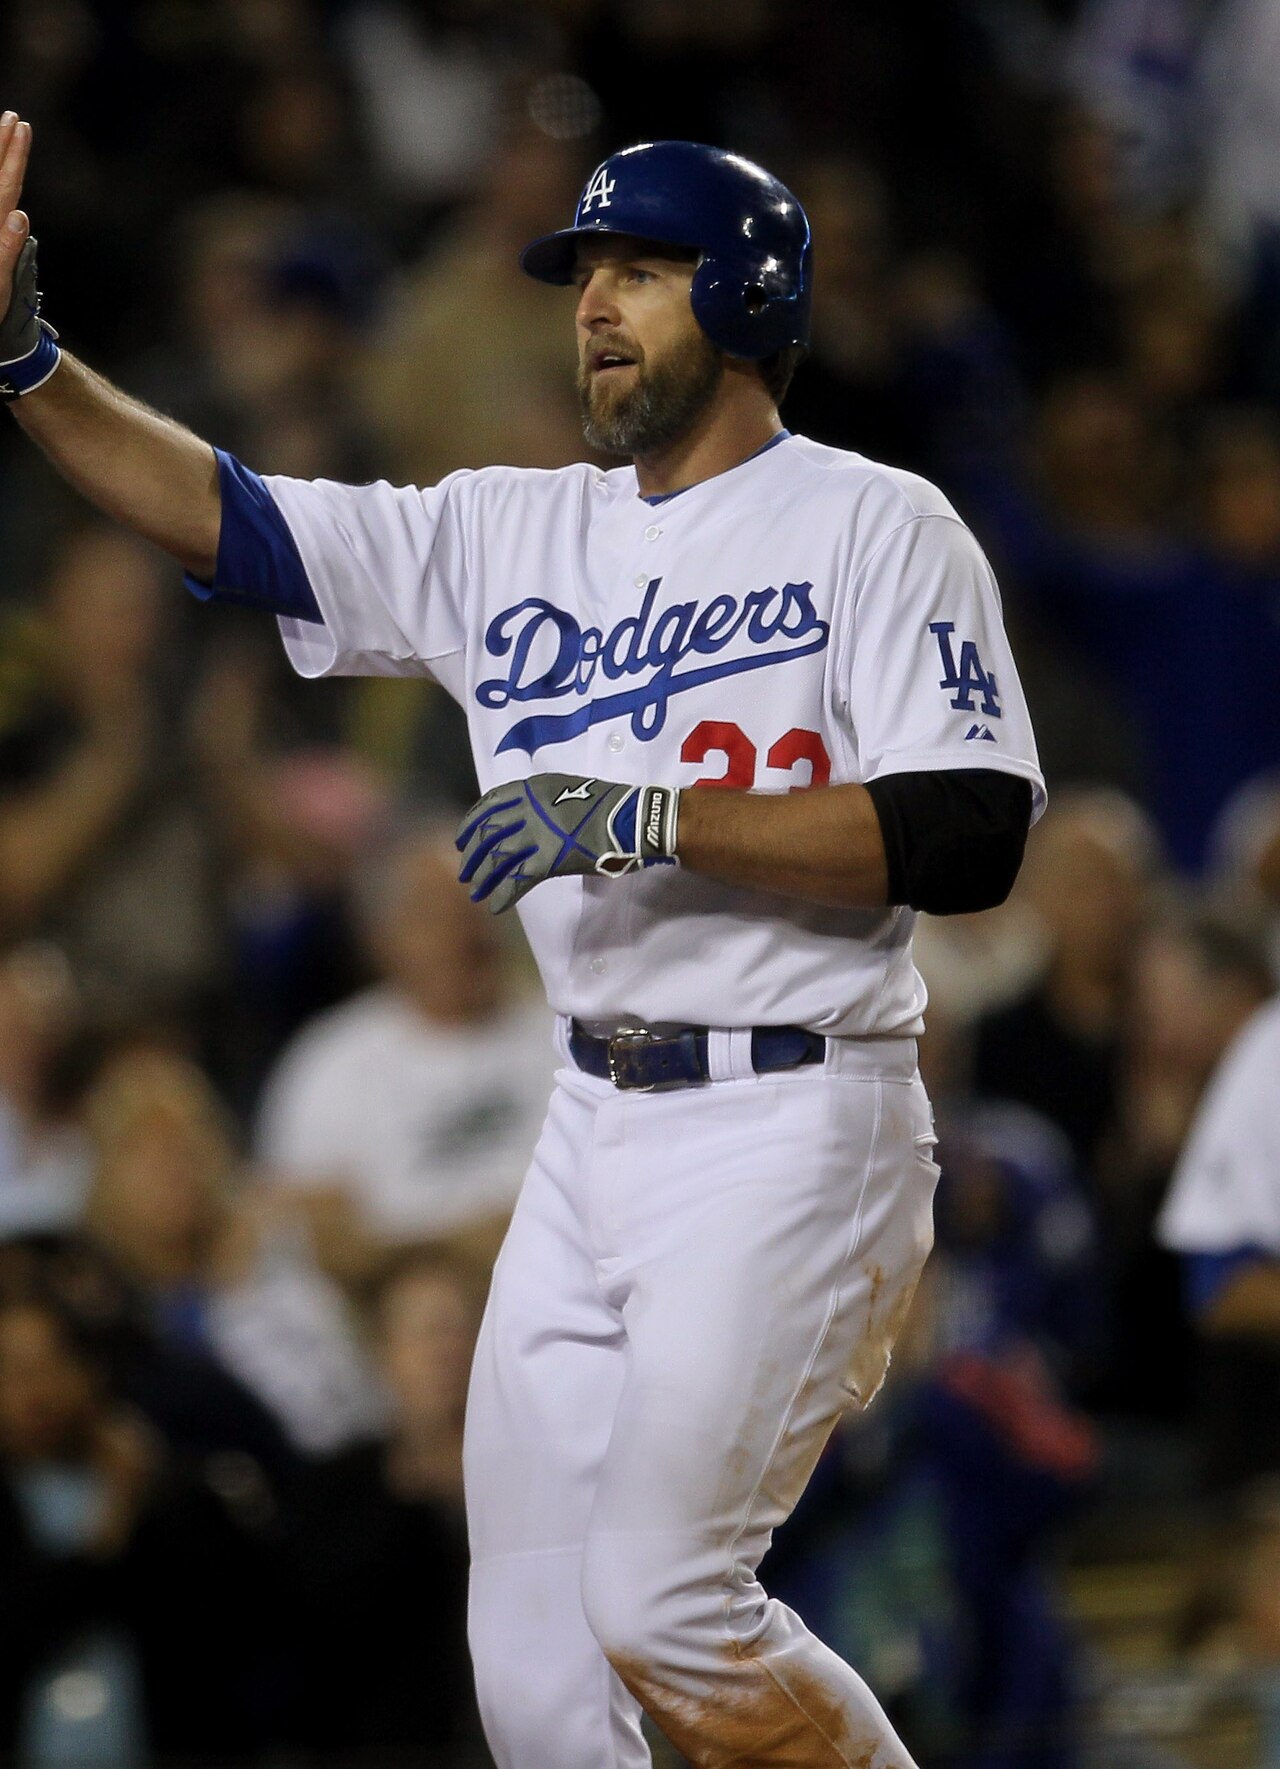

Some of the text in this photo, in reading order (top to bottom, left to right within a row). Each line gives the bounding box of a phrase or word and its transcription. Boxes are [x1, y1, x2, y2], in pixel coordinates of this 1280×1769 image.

[582, 160, 616, 215] LA
[475, 576, 830, 742] Dodgers
[928, 621, 1002, 719] LA
[646, 792, 663, 848] MIZUNO
